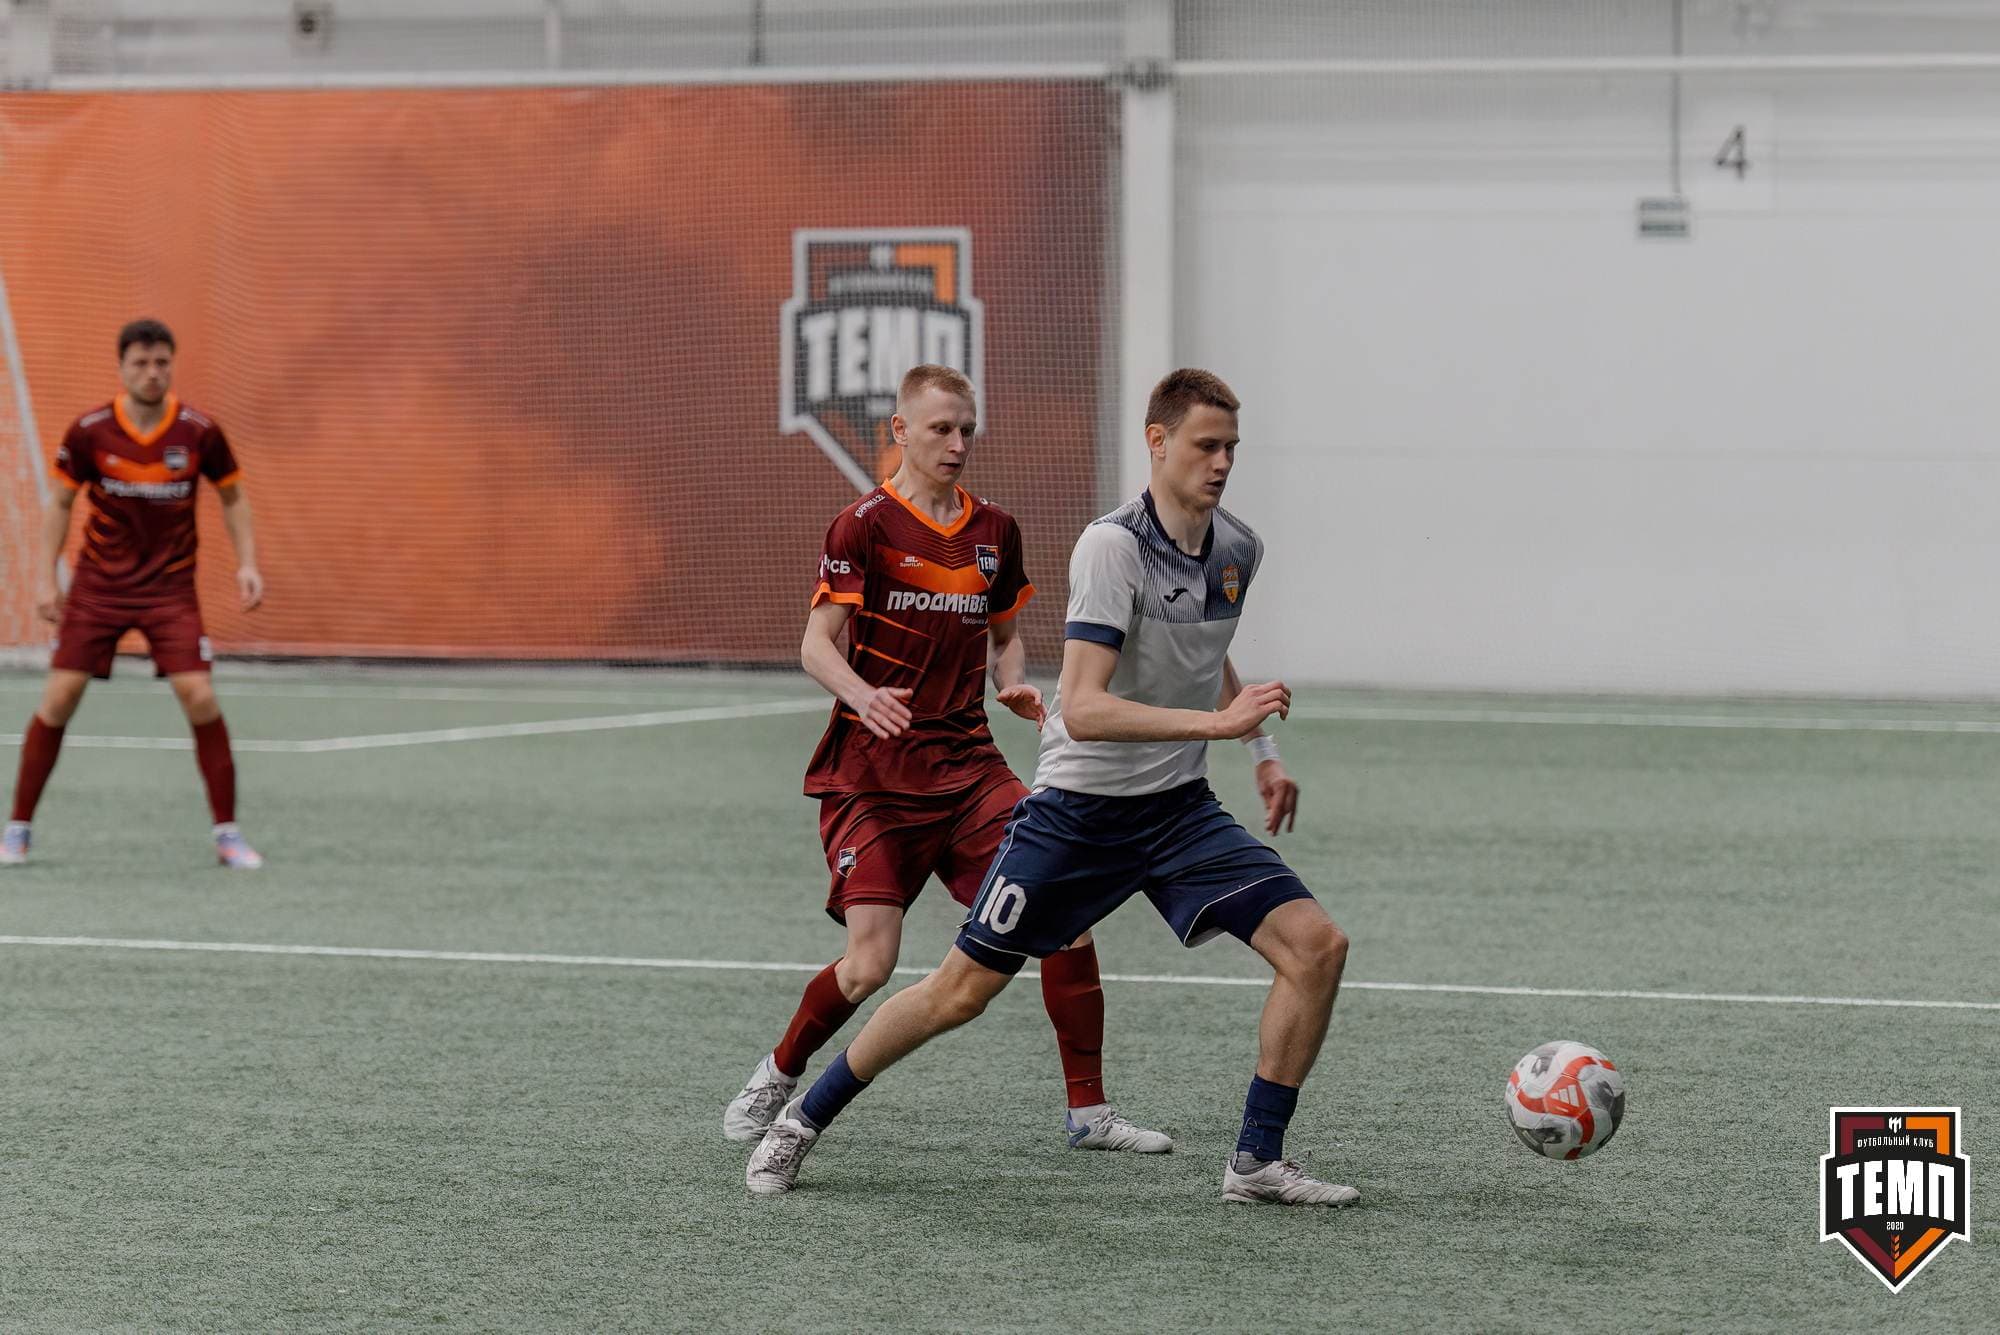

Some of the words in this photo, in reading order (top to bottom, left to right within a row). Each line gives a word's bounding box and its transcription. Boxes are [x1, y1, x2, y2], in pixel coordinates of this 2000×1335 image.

[1714, 126, 1752, 181] 4
[802, 307, 965, 402] ТЕМП
[978, 875, 1027, 934] 10
